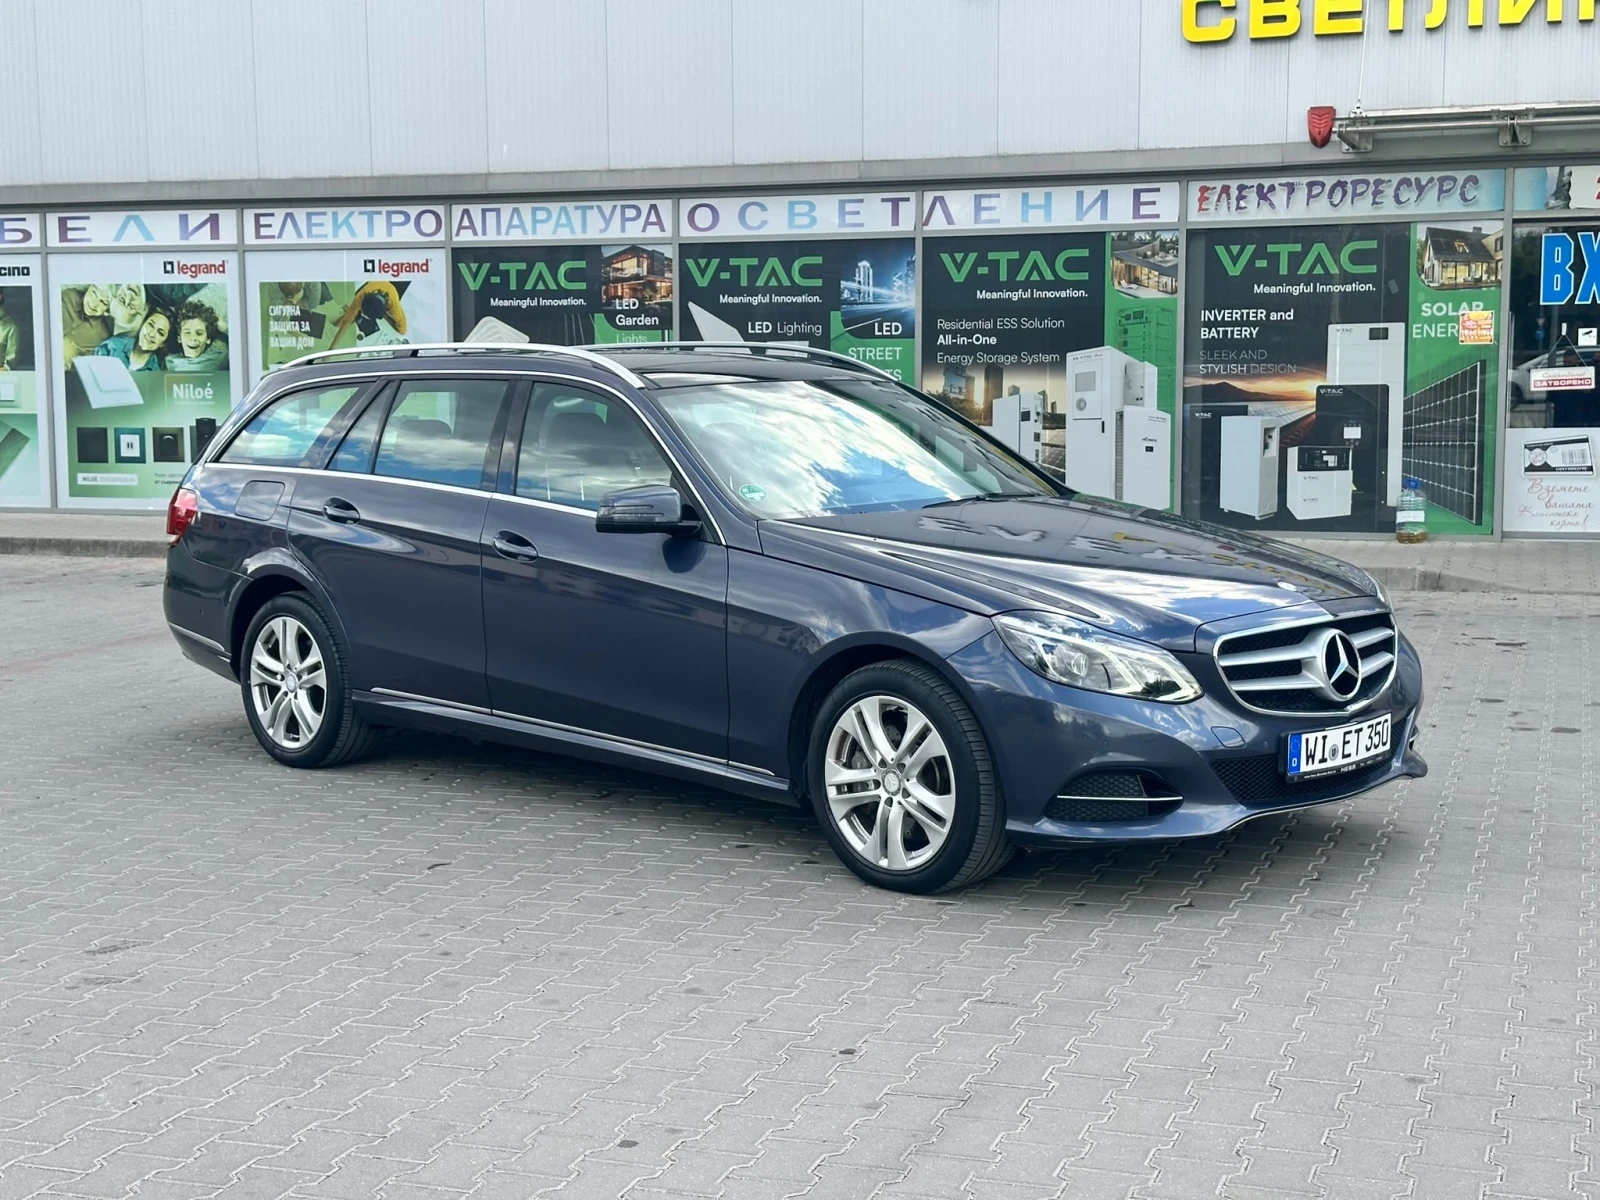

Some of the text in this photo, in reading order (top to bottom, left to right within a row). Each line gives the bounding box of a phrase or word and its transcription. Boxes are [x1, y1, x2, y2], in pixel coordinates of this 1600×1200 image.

[1198, 175, 1479, 213] ЕЛЕКТРОРЕСУРС
[1214, 240, 1378, 276] V-TAC
[177, 260, 225, 278] legrand
[378, 258, 429, 278] legrand
[685, 256, 823, 287] V-TAC
[939, 248, 1089, 283] V-TAC
[457, 260, 587, 291] V-TAC
[976, 288, 1088, 301] Meaningful Innovation.
[1253, 281, 1376, 296] Meaningful Innovation.
[490, 297, 587, 309] Meaningful Innovation.
[615, 298, 639, 310] LED
[719, 293, 823, 306] Meaningful Innovation.
[269, 305, 301, 316] СИГУРНА
[1201, 308, 1294, 322] INVERTER and
[615, 314, 659, 326] Garden
[936, 317, 1065, 330] Residential ESS Solution
[269, 321, 311, 334] ЗАЩИТА ЗА
[748, 321, 823, 336] LED Lighting
[874, 322, 903, 336] LED
[1200, 326, 1260, 339] BATTERY
[297, 337, 315, 350] ДОМ
[936, 334, 997, 346] All-in-One
[848, 347, 903, 360] STREET
[936, 353, 973, 366] Energy
[976, 352, 1018, 365] Storage
[1021, 352, 1060, 365] System
[1199, 349, 1268, 361] SLEEK AND
[1199, 363, 1297, 374] STYLISH DESIGN
[172, 382, 214, 400] Niloé
[1291, 757, 1297, 767] D
[1305, 735, 1328, 766] WI
